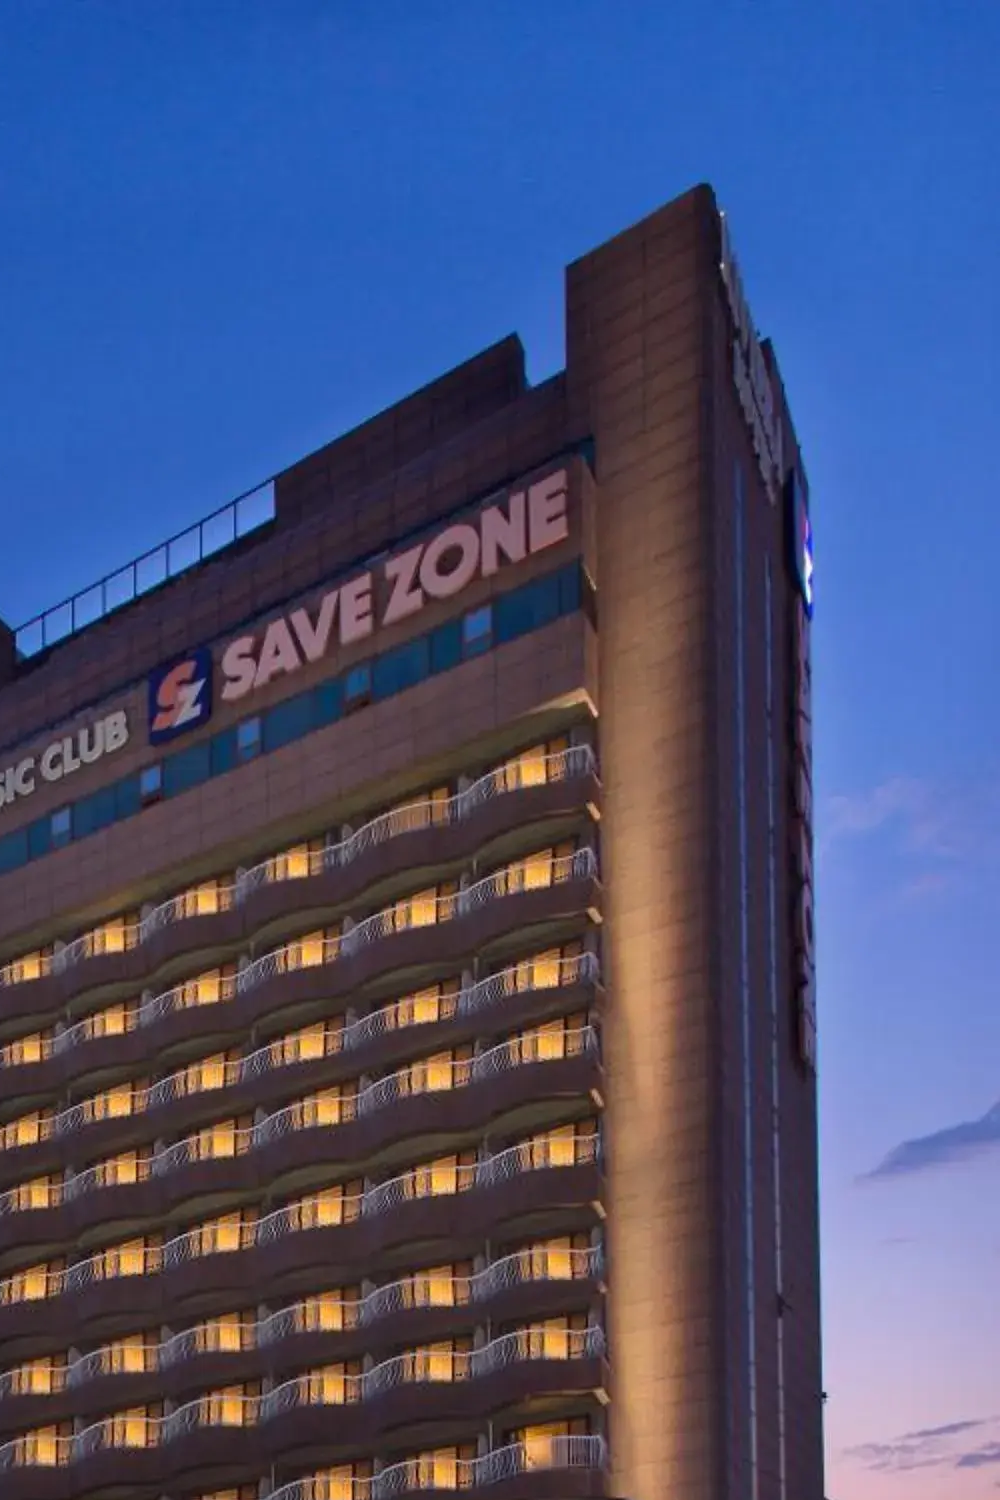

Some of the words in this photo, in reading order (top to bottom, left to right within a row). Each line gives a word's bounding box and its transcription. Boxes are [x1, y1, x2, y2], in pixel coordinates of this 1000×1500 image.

[221, 571, 374, 700] SAVE
[382, 469, 569, 627] ZONE
[40, 711, 129, 782] CLUB
